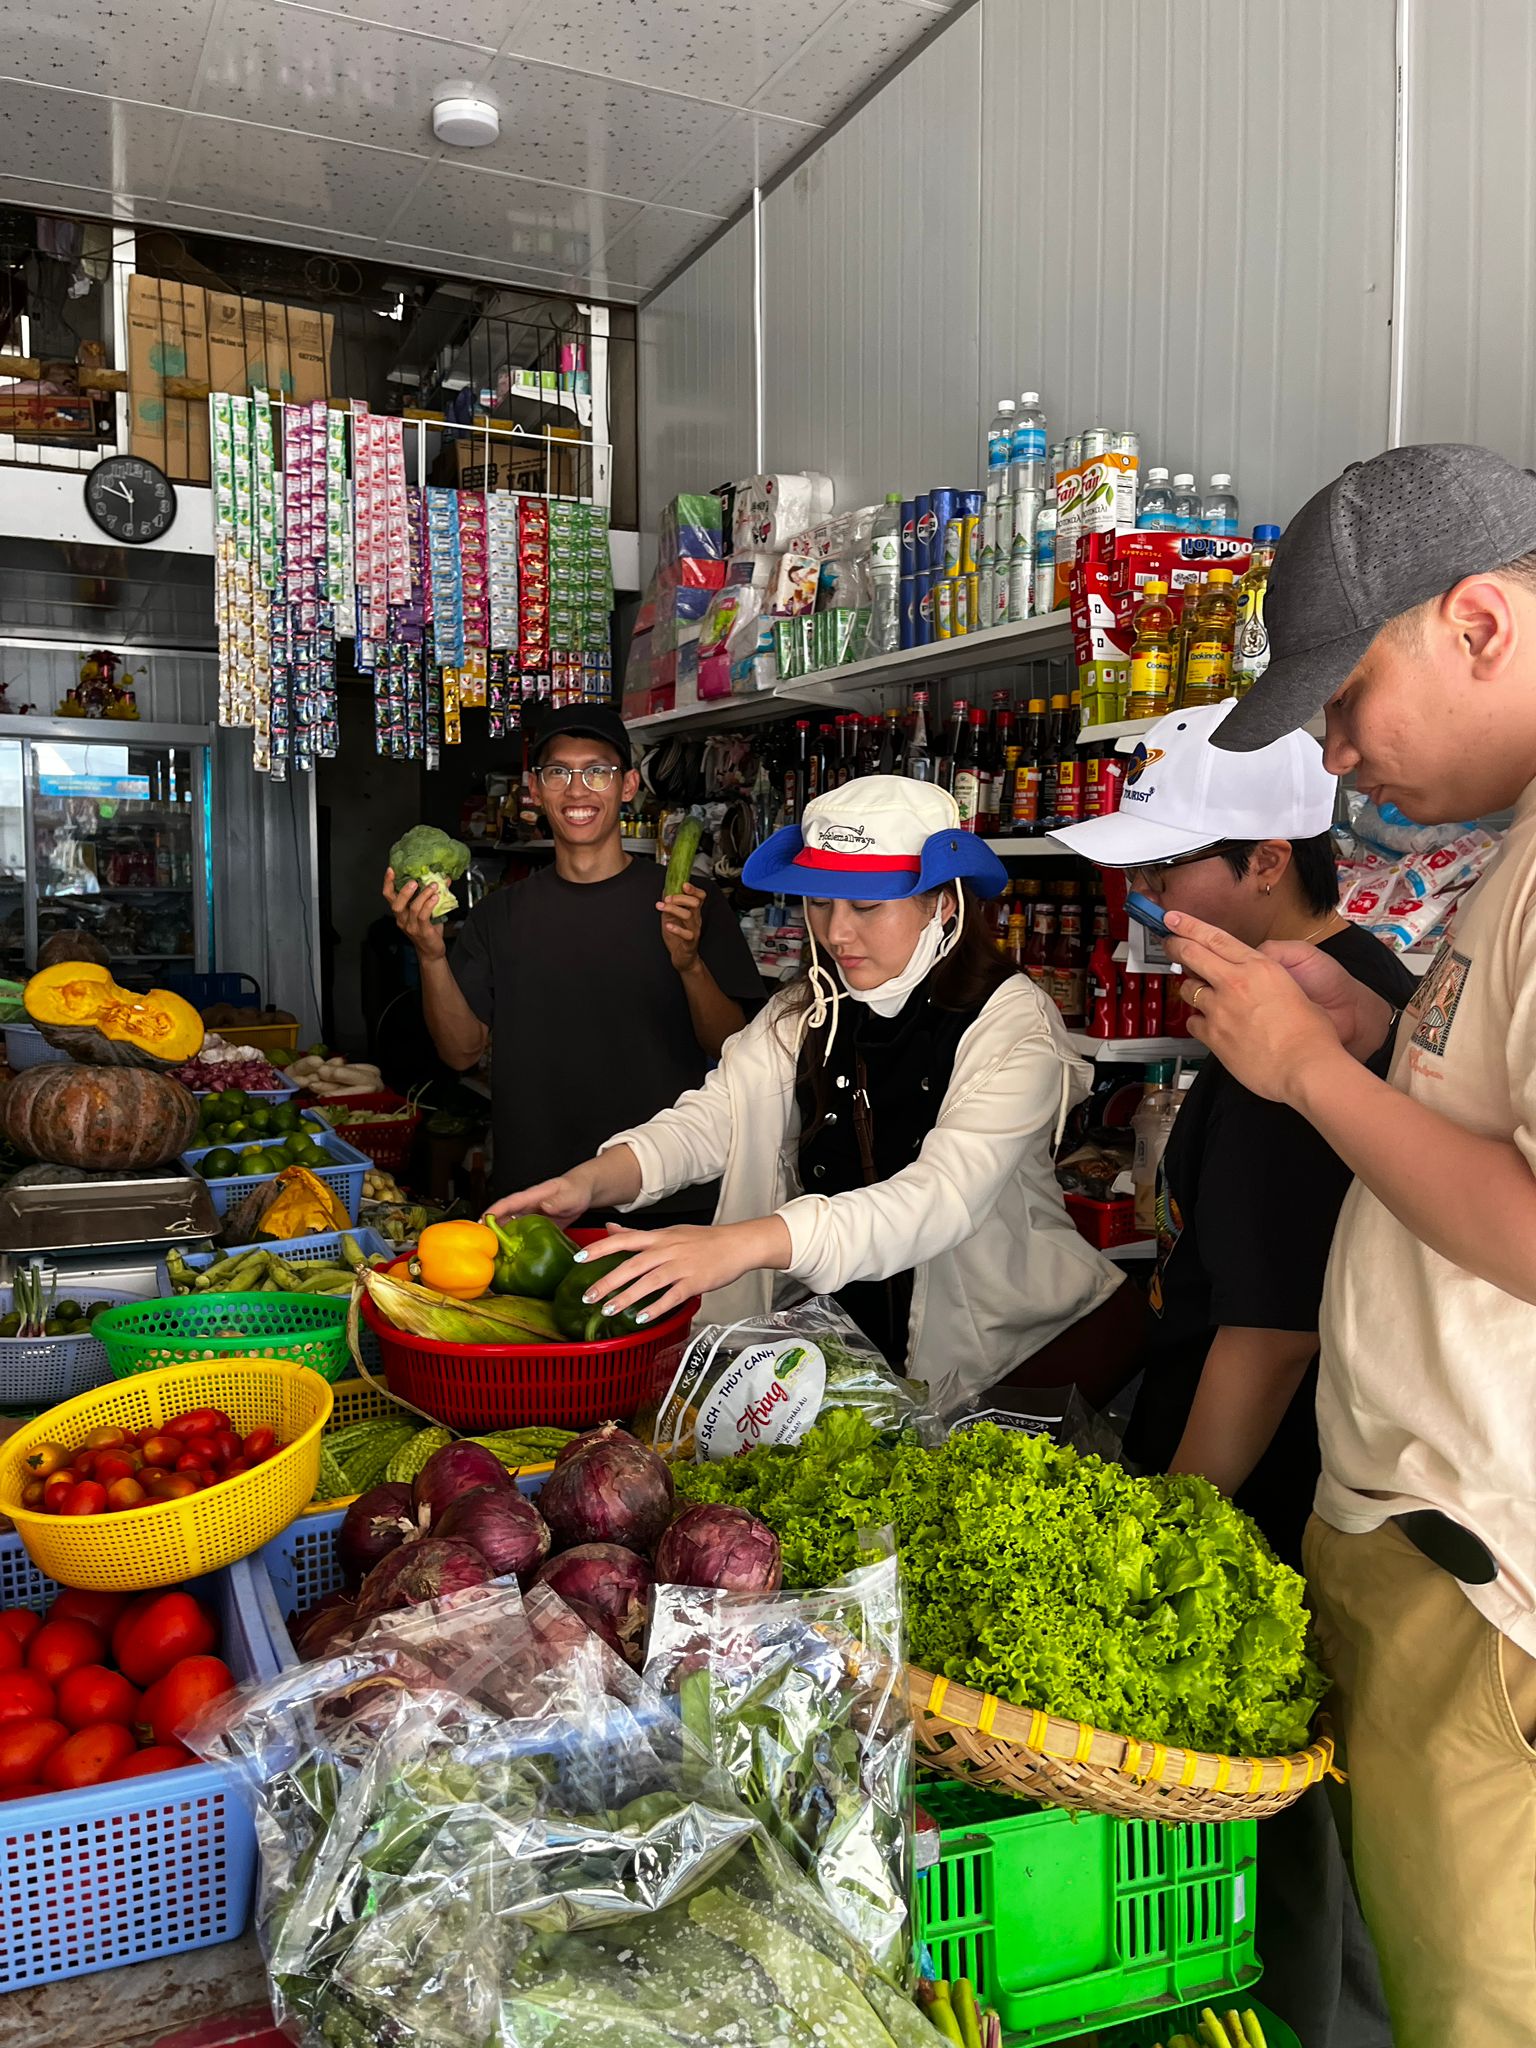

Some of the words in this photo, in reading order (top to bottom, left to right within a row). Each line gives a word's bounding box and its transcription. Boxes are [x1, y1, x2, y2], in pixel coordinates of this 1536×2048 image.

[1180, 538, 1253, 557] oodfoil
[701, 1406, 721, 1440] SẠCH
[718, 1367, 744, 1399] THỦY
[744, 1349, 776, 1371] CANH
[736, 1380, 790, 1438] Hùng
